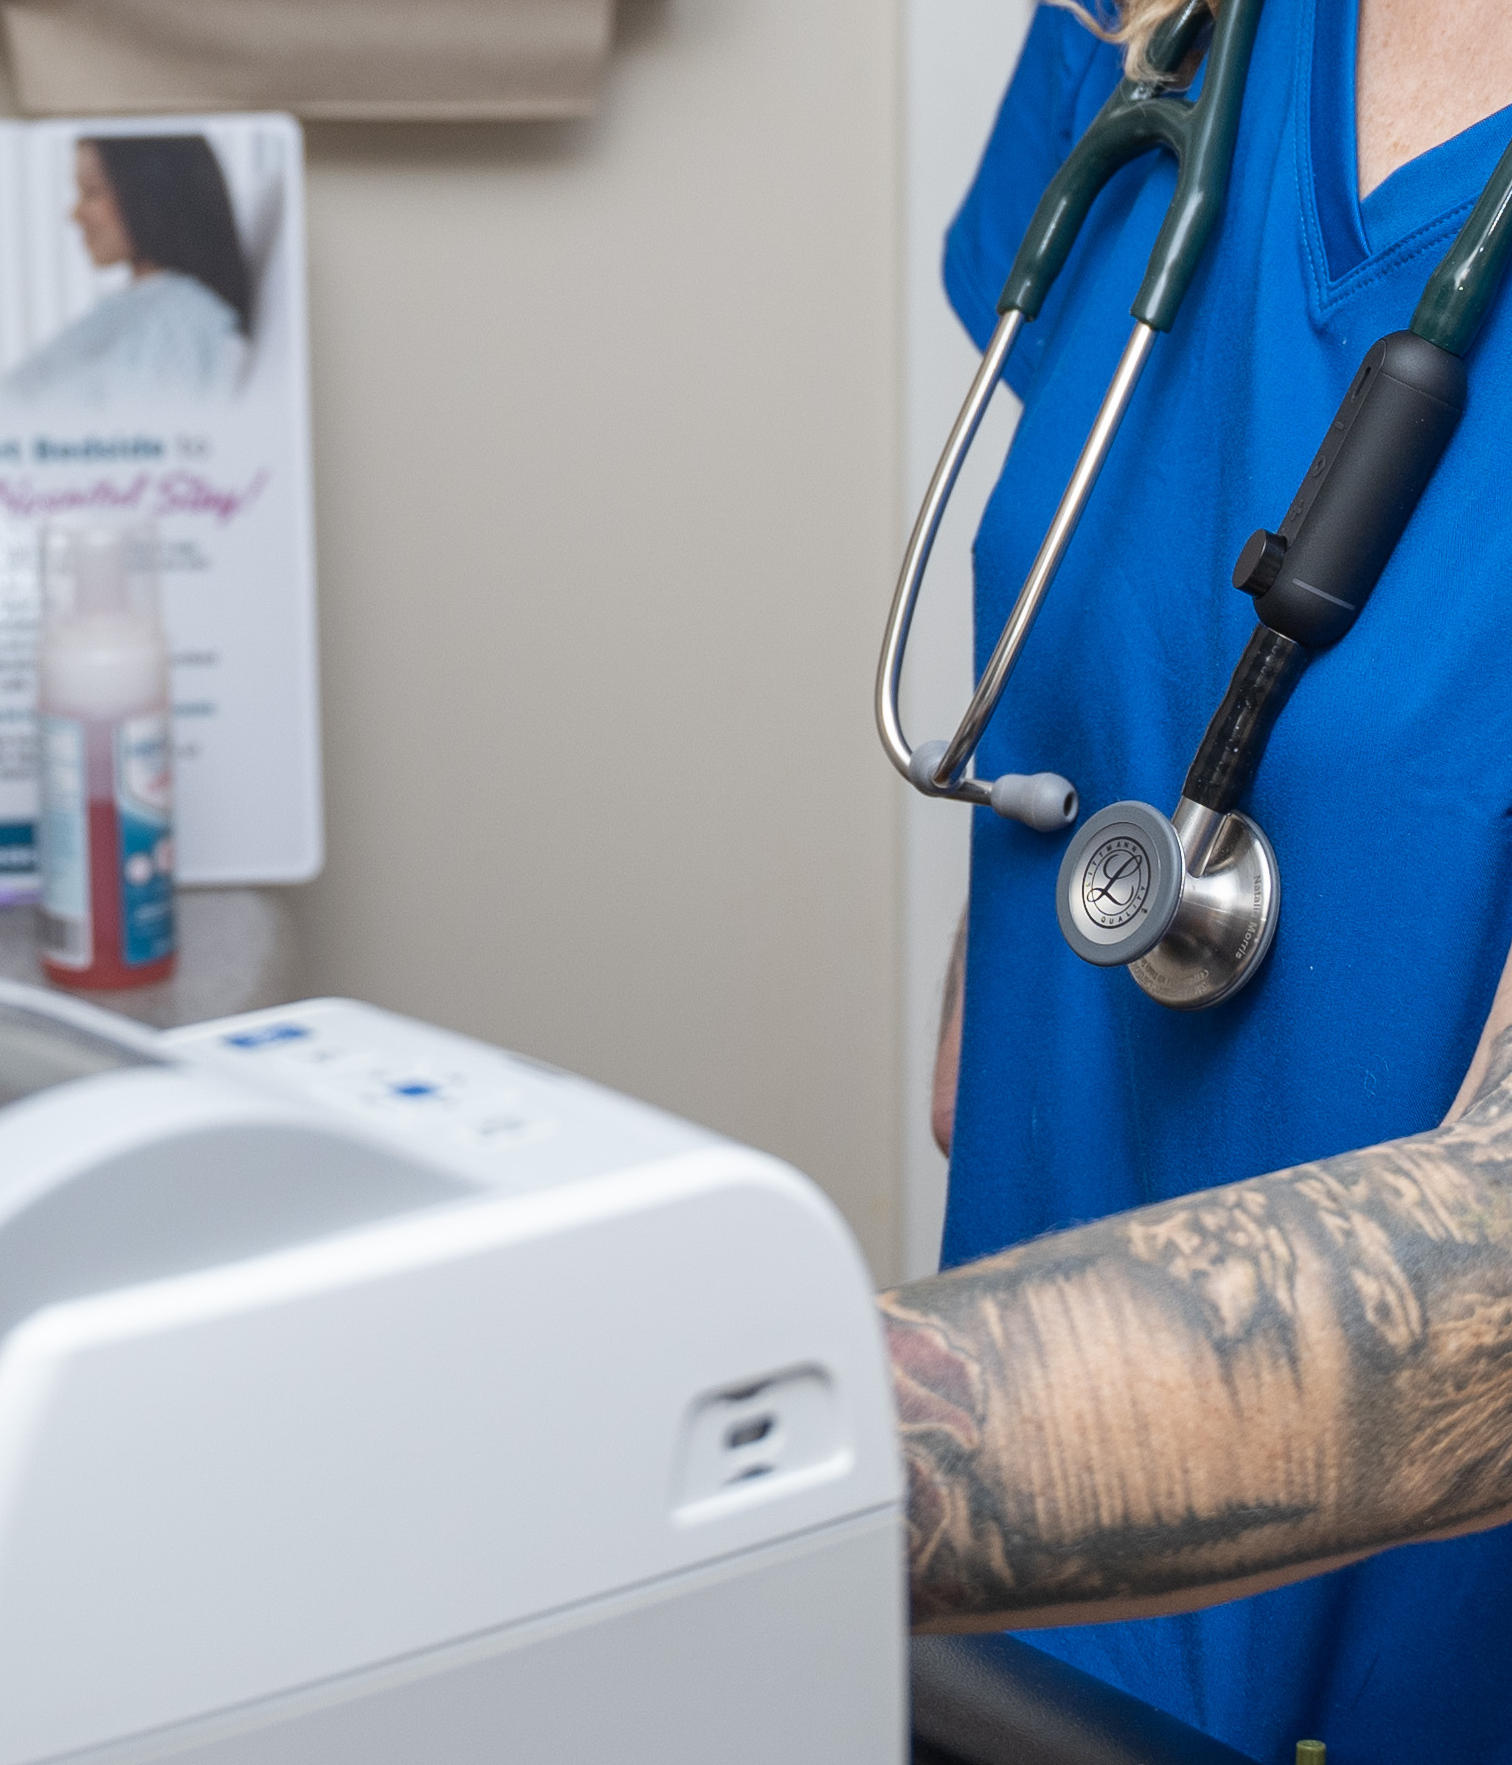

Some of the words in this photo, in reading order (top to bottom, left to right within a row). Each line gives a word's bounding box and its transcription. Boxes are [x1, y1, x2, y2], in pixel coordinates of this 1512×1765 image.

[1085, 841, 1138, 887] LITTMANN
[1101, 886, 1145, 924] QUALITY
[1235, 921, 1258, 959] Morris
